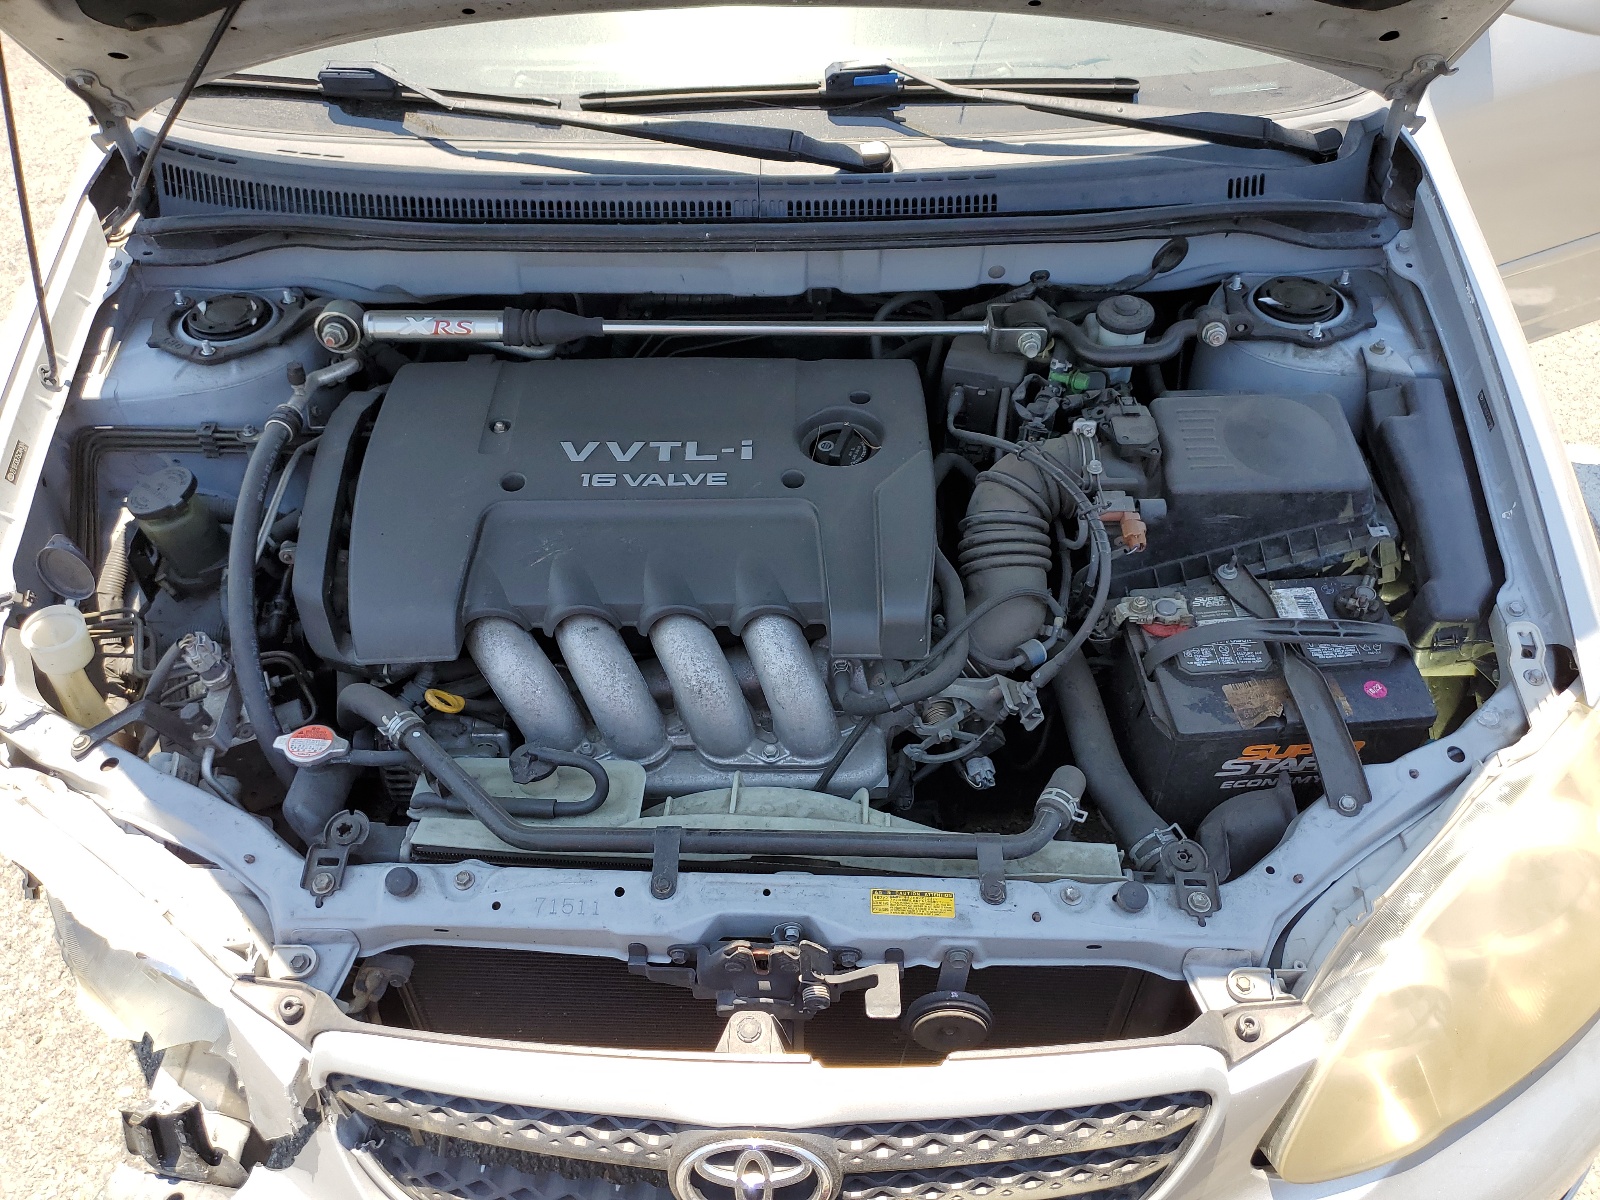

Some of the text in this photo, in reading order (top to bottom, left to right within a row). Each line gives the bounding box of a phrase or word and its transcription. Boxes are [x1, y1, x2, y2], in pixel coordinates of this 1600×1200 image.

[399, 316, 474, 335] XRS
[560, 439, 753, 462] VVTL-i
[580, 472, 728, 487] 16 VALVE
[1219, 775, 1322, 789] ECONMY
[534, 897, 600, 917] 71511
